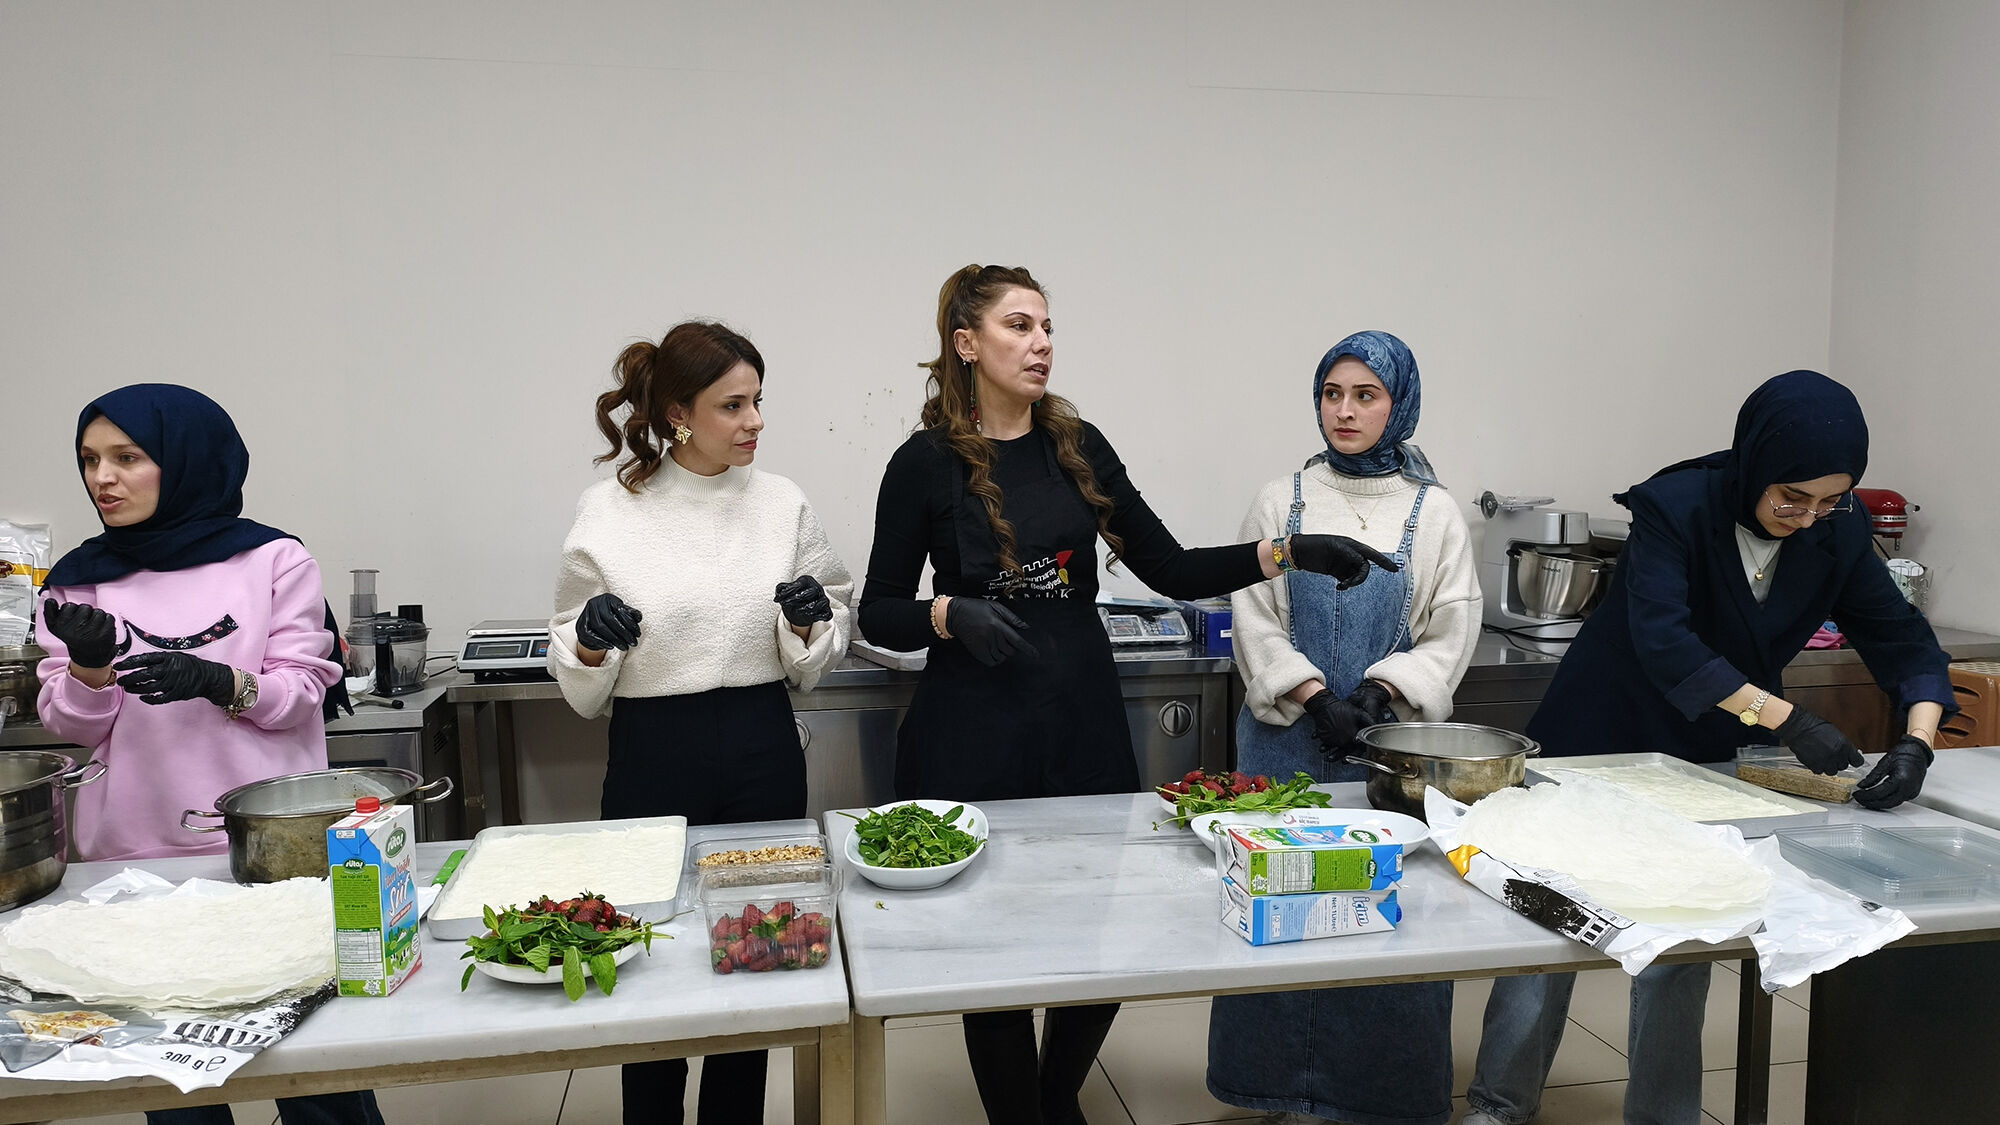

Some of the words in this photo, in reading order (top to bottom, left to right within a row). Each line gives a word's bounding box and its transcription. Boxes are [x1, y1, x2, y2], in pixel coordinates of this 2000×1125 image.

[989, 567, 1057, 587] Kahraanmaraş
[161, 1051, 192, 1065] 300
[192, 1059, 205, 1071] g
